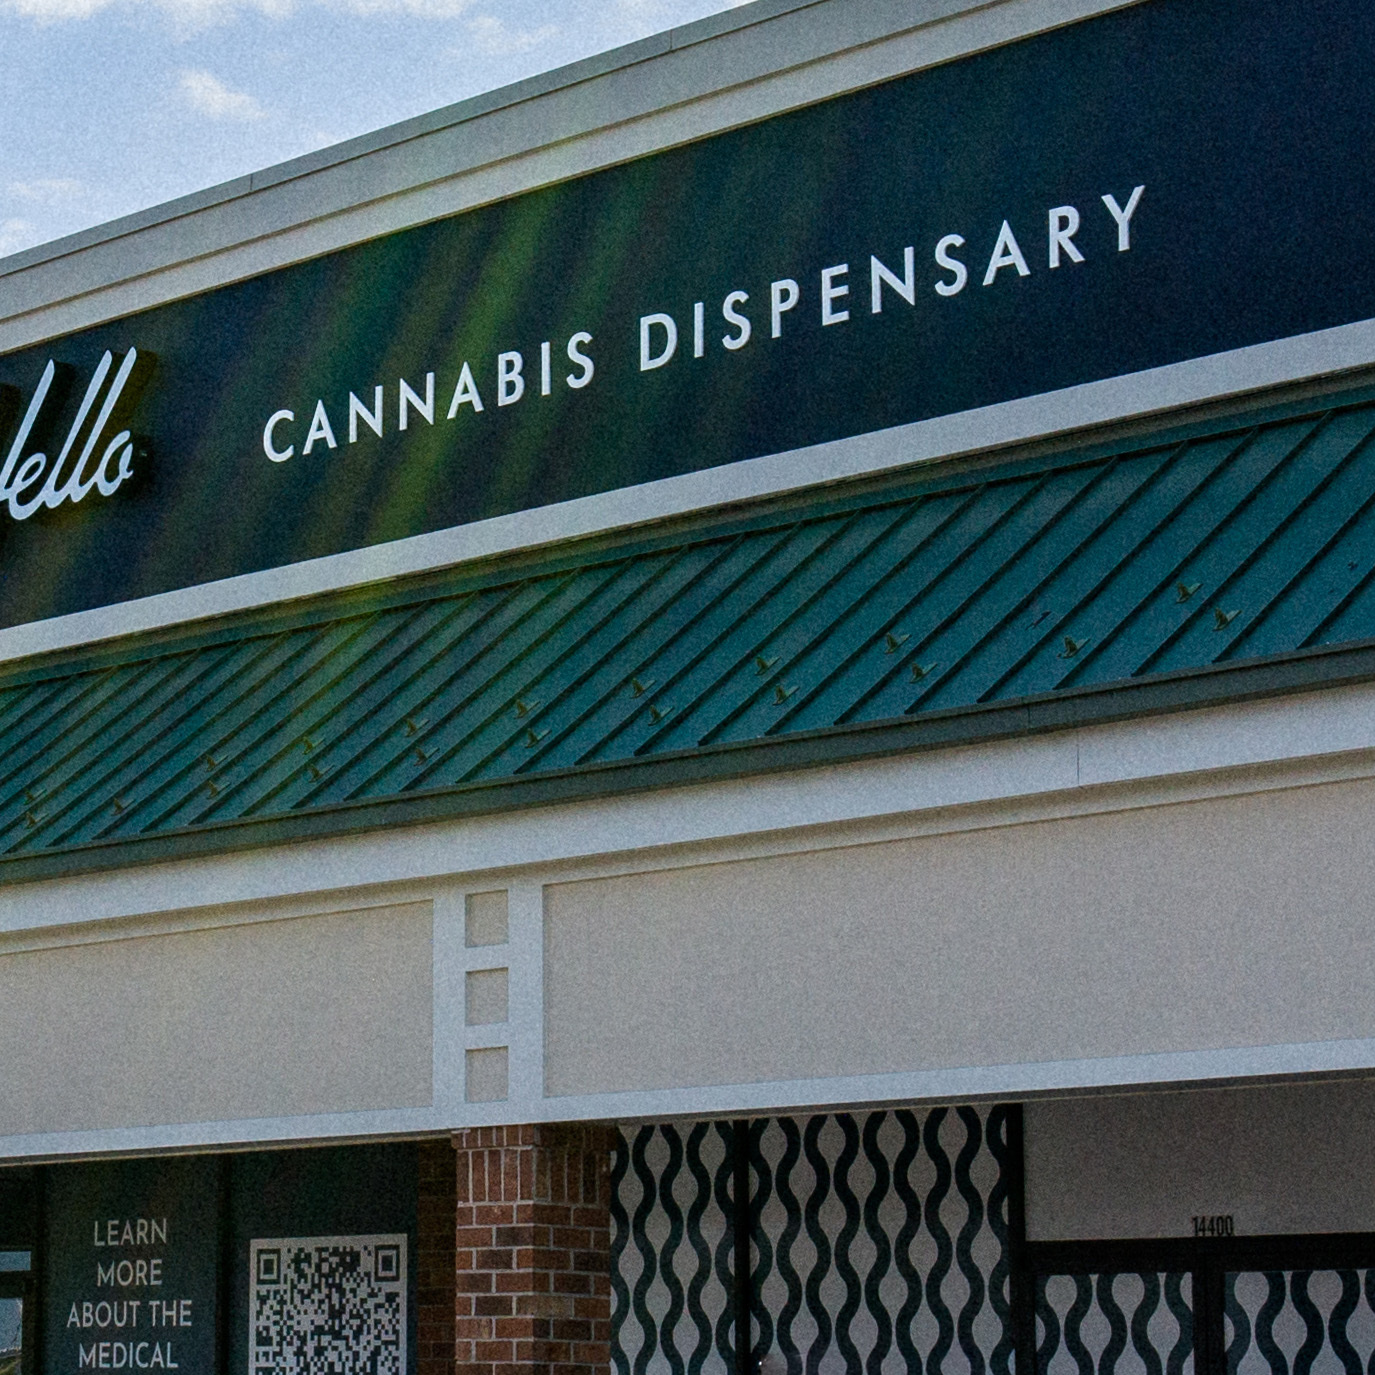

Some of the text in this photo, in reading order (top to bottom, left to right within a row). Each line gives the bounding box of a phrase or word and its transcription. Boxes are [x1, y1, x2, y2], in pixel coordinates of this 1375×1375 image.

[262, 184, 1148, 464] CANNABIS DISPENSARY
[94, 1219, 166, 1246] LEARN
[1191, 1215, 1234, 1236] 14400
[97, 1259, 162, 1286] MORE
[66, 1300, 192, 1328] ABOUT THE
[78, 1342, 179, 1369] MEDICAL
